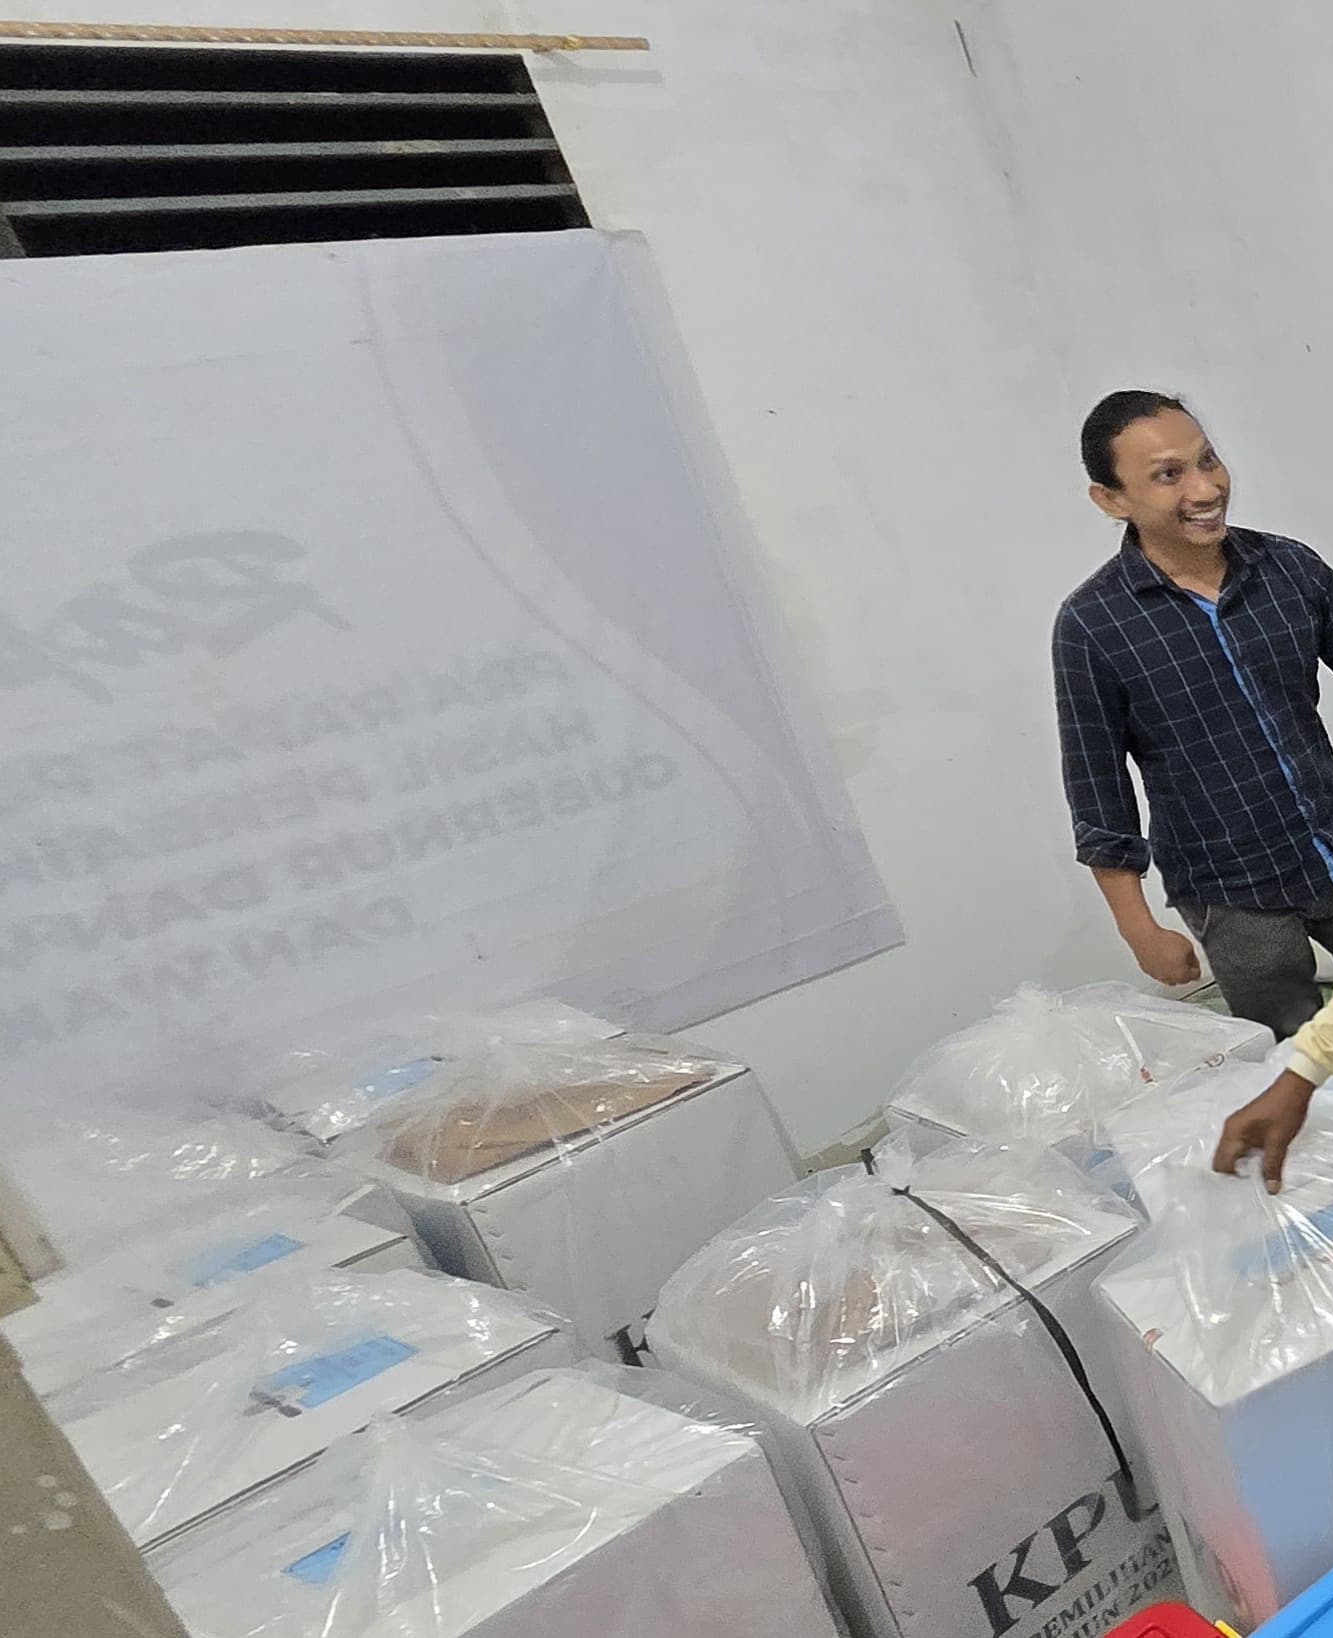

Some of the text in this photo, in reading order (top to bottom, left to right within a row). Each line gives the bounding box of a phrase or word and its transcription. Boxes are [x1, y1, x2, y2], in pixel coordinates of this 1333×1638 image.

[967, 1469, 1159, 1638] KPU
[1030, 1526, 1173, 1638] EMILIHAN
[1127, 1557, 1174, 1606] 202
